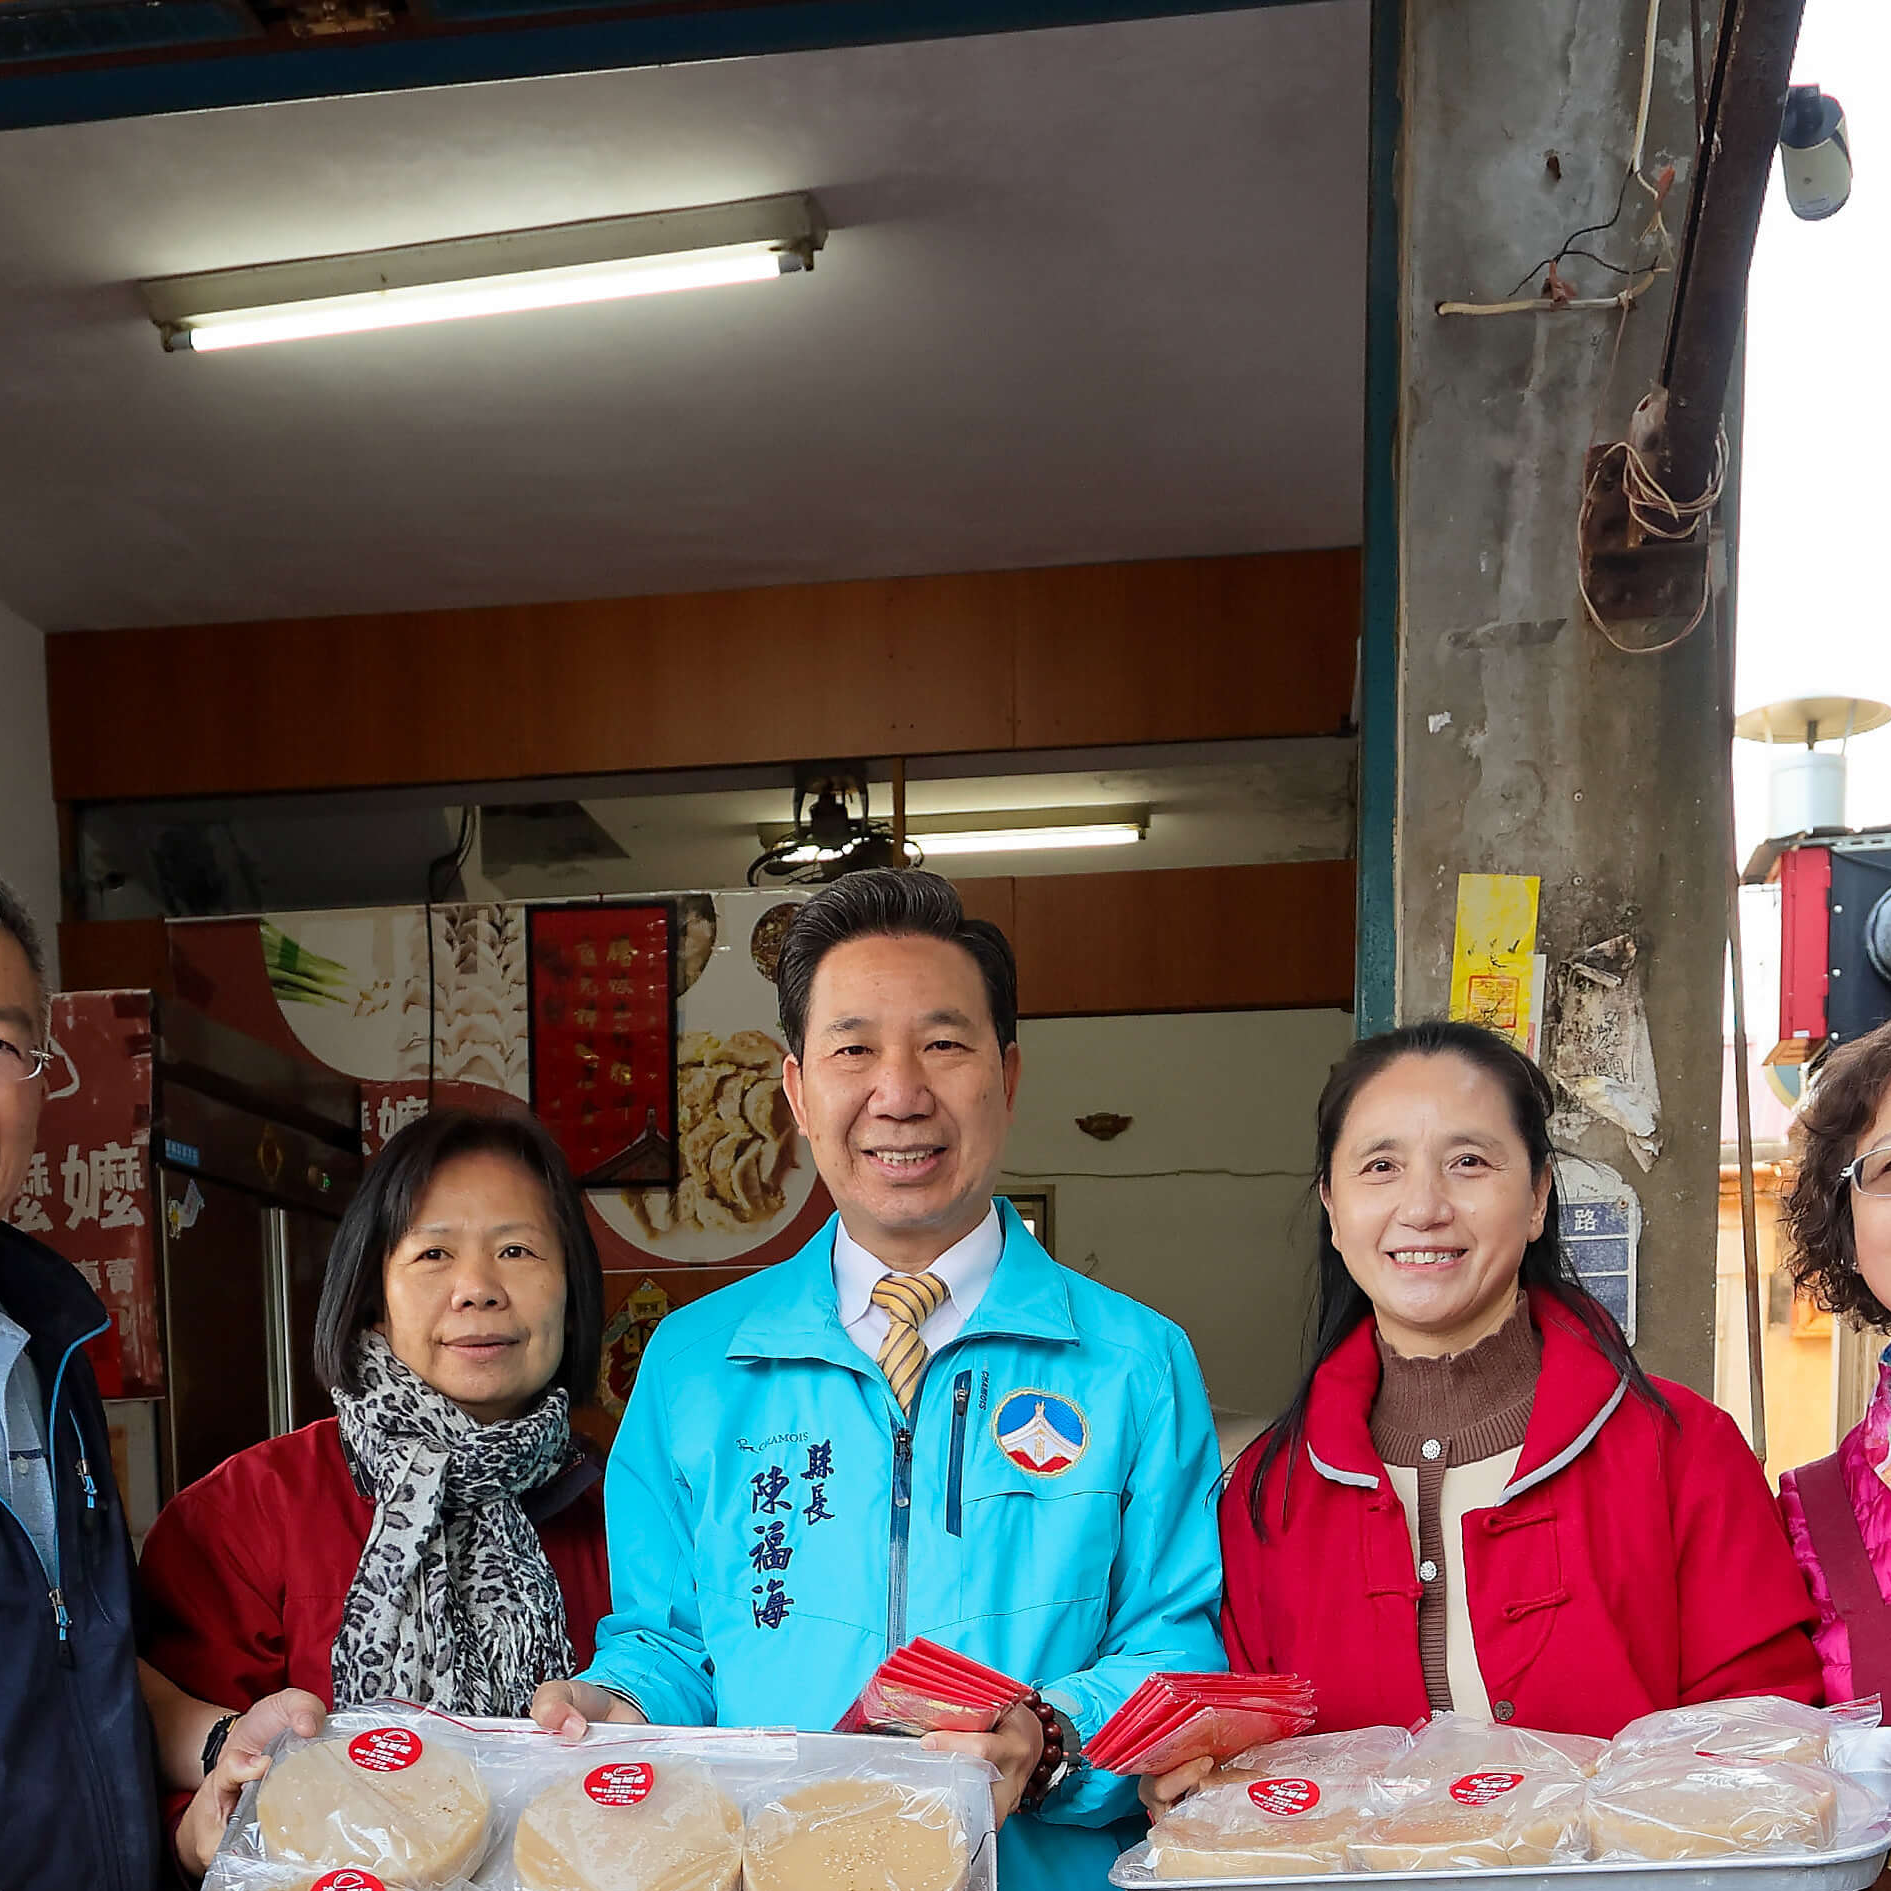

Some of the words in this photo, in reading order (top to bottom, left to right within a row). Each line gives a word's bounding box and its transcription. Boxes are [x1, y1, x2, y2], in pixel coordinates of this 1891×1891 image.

[1574, 1209, 1597, 1232] 路
[800, 1439, 835, 1526] 縣長
[749, 1465, 795, 1629] 陳福海
